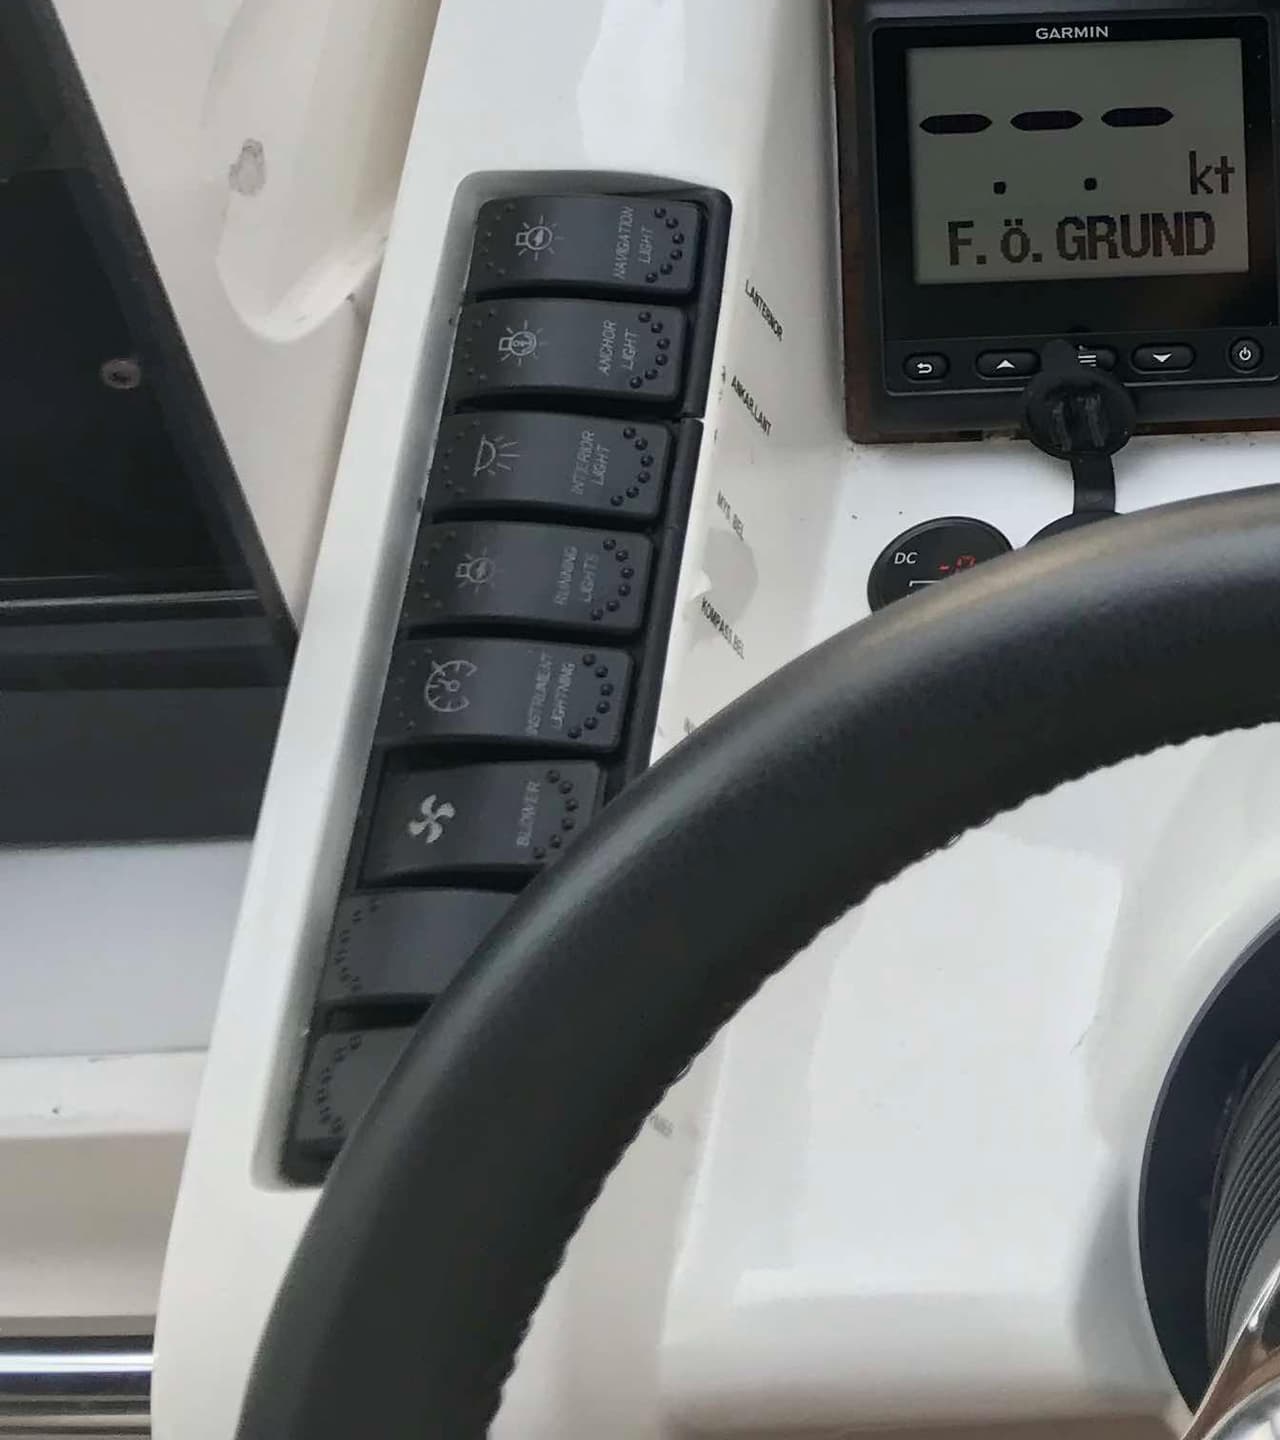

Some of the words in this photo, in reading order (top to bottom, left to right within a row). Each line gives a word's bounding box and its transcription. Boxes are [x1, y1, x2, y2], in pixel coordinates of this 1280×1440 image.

[1035, 25, 1109, 40] GARMIN
[1188, 150, 1235, 195] kt
[611, 206, 634, 279] NAVIGATION
[639, 227, 655, 264] LIGHT
[1056, 211, 1215, 261] GRUND
[745, 279, 783, 342] LANTERNOR
[599, 320, 617, 376] ANCHOR
[621, 330, 641, 371] LIGHT
[554, 545, 578, 606] RUNNING
[894, 552, 918, 565] DC
[516, 781, 541, 848] BLOWER
